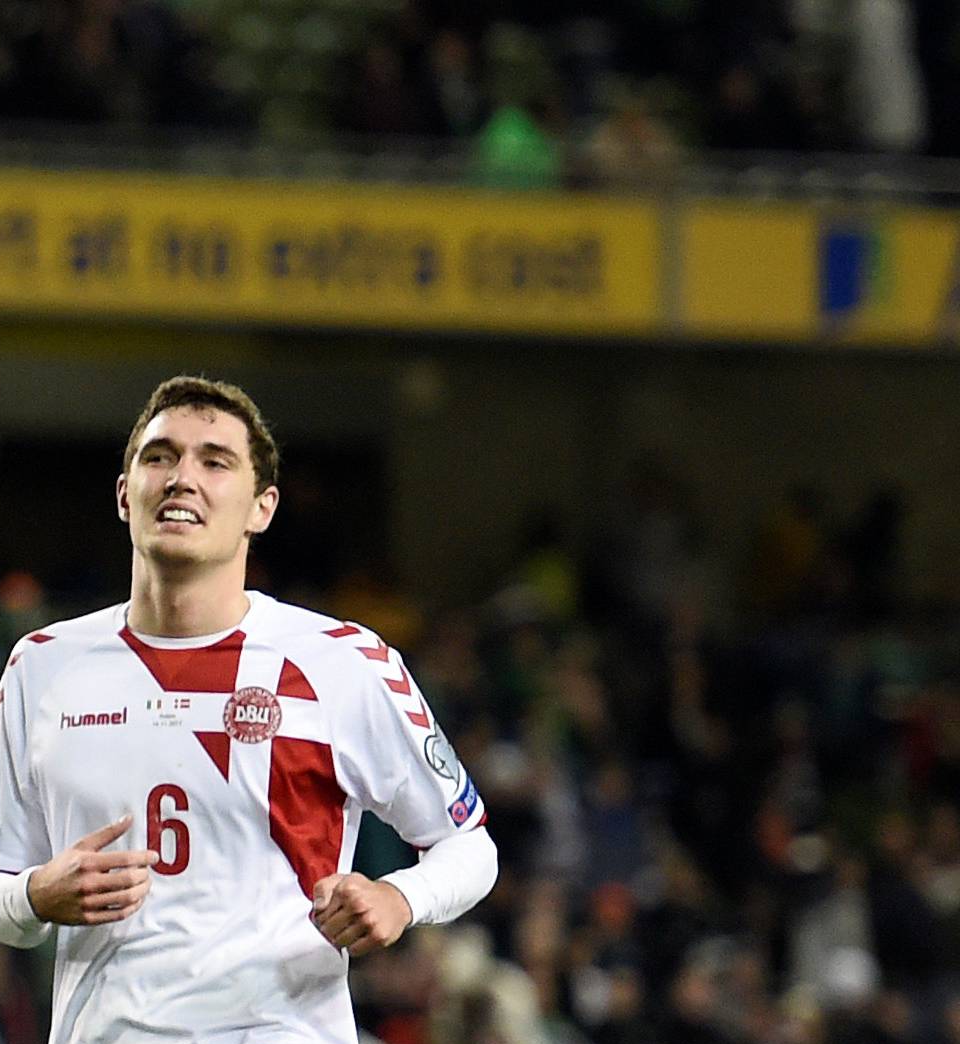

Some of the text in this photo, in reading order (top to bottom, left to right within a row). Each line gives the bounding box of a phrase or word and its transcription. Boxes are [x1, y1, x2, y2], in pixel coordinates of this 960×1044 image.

[60, 707, 128, 730] hummel
[235, 704, 269, 724] DBU
[146, 783, 190, 876] 6
